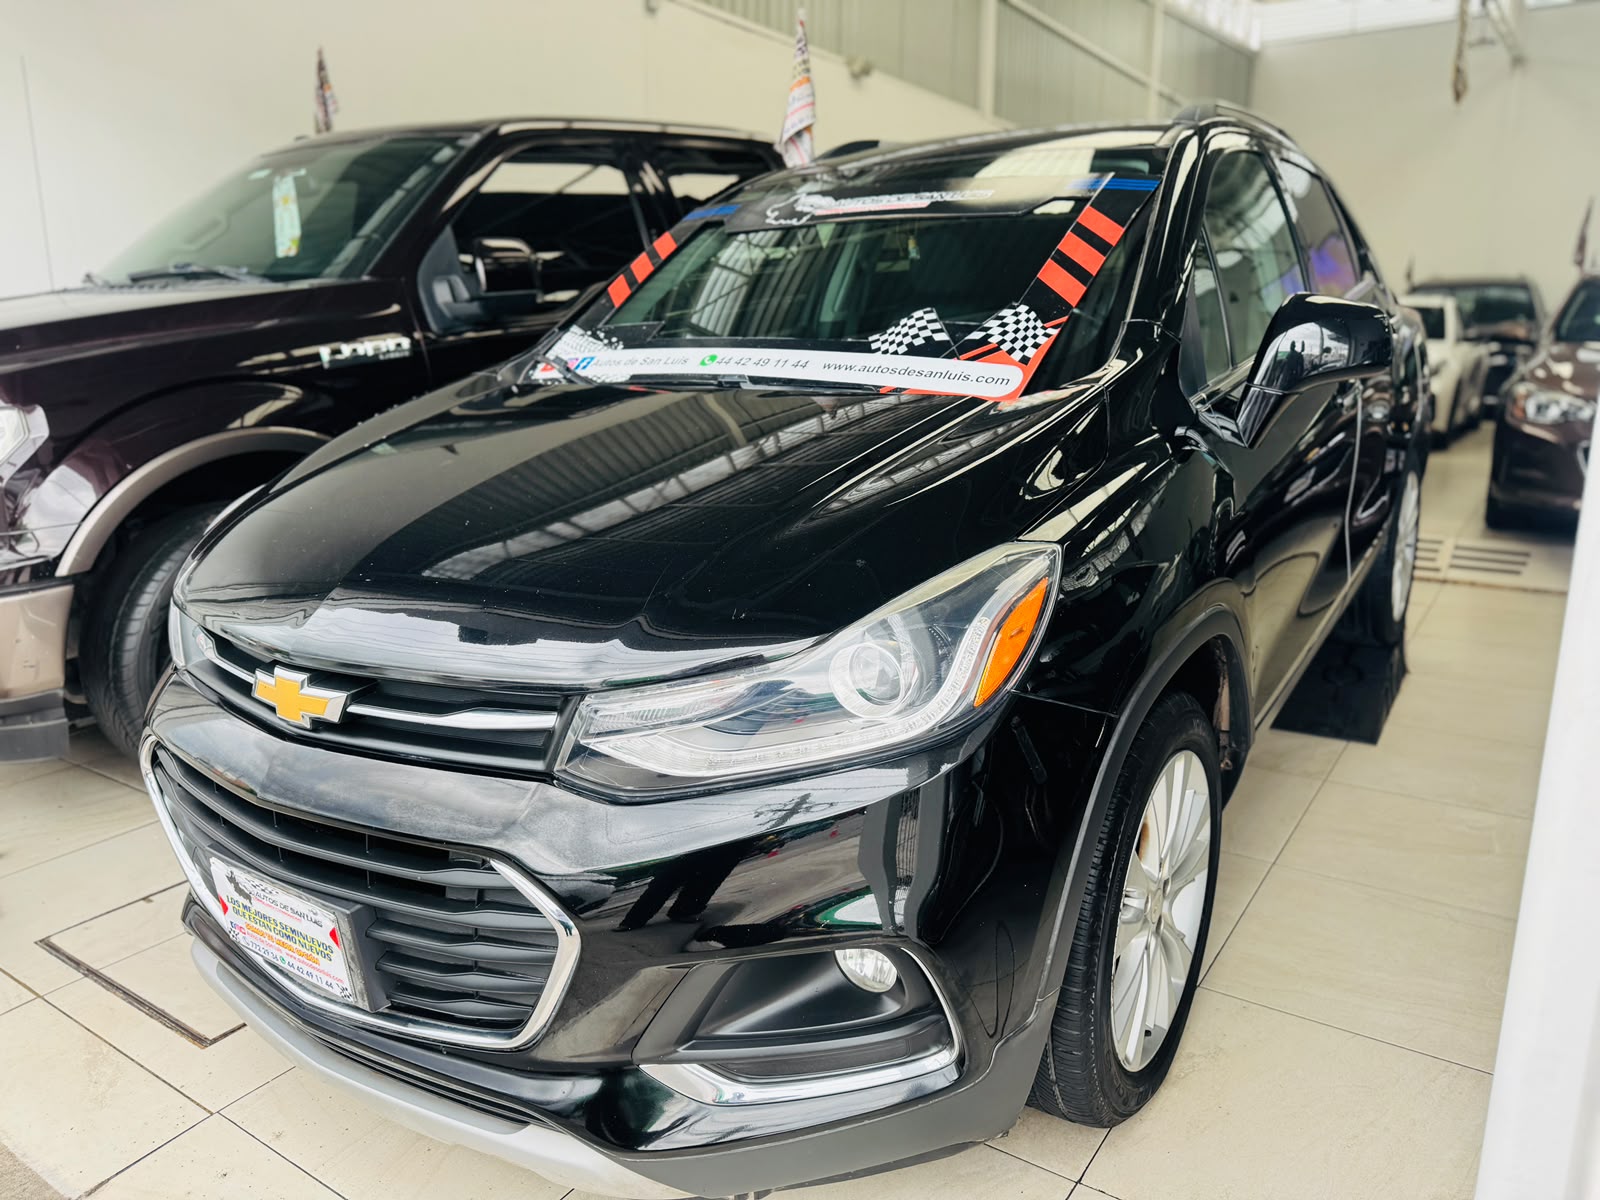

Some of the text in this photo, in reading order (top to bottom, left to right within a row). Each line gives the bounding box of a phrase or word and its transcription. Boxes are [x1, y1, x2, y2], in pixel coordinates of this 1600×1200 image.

[625, 356, 637, 366] de
[639, 355, 661, 366] San
[664, 356, 688, 366] Luis
[716, 354, 731, 366] 44
[735, 355, 751, 367] 42
[754, 357, 769, 367] 49
[774, 358, 788, 369] 11
[792, 359, 809, 370] 44
[823, 360, 1010, 386] www.autosdesanluis.com
[226, 894, 240, 907] LOS
[240, 901, 278, 926] MEJORES
[279, 921, 333, 953] SEMINUEVOS
[232, 905, 247, 919] QUE
[248, 912, 272, 932] ESTAN
[273, 925, 296, 944] COMO
[296, 938, 332, 962] NUEVOS
